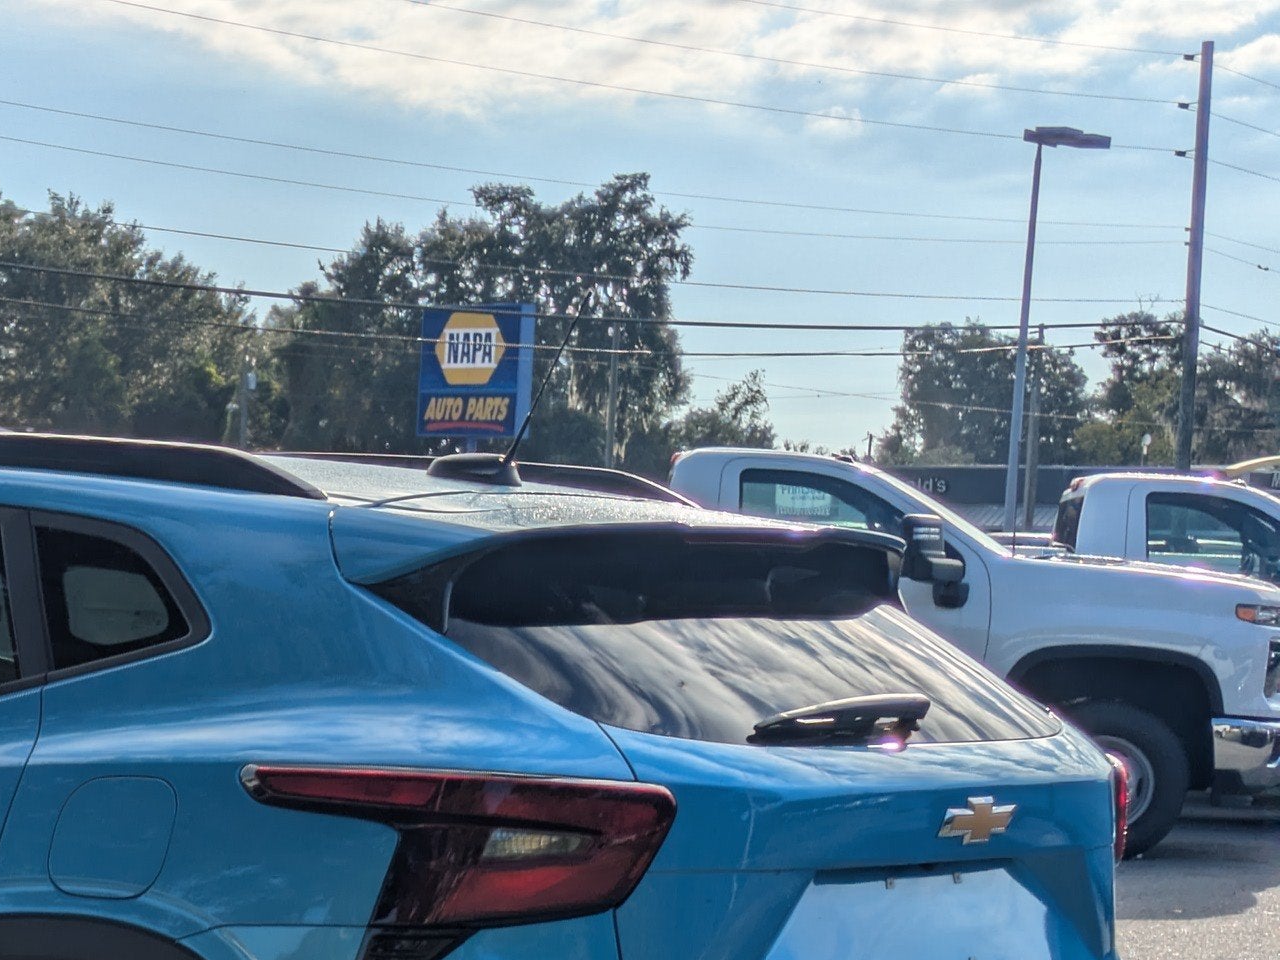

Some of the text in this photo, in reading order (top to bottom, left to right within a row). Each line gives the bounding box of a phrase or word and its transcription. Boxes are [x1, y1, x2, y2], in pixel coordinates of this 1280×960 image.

[447, 331, 492, 364] NAPA
[424, 396, 510, 421] AUTO PARTS
